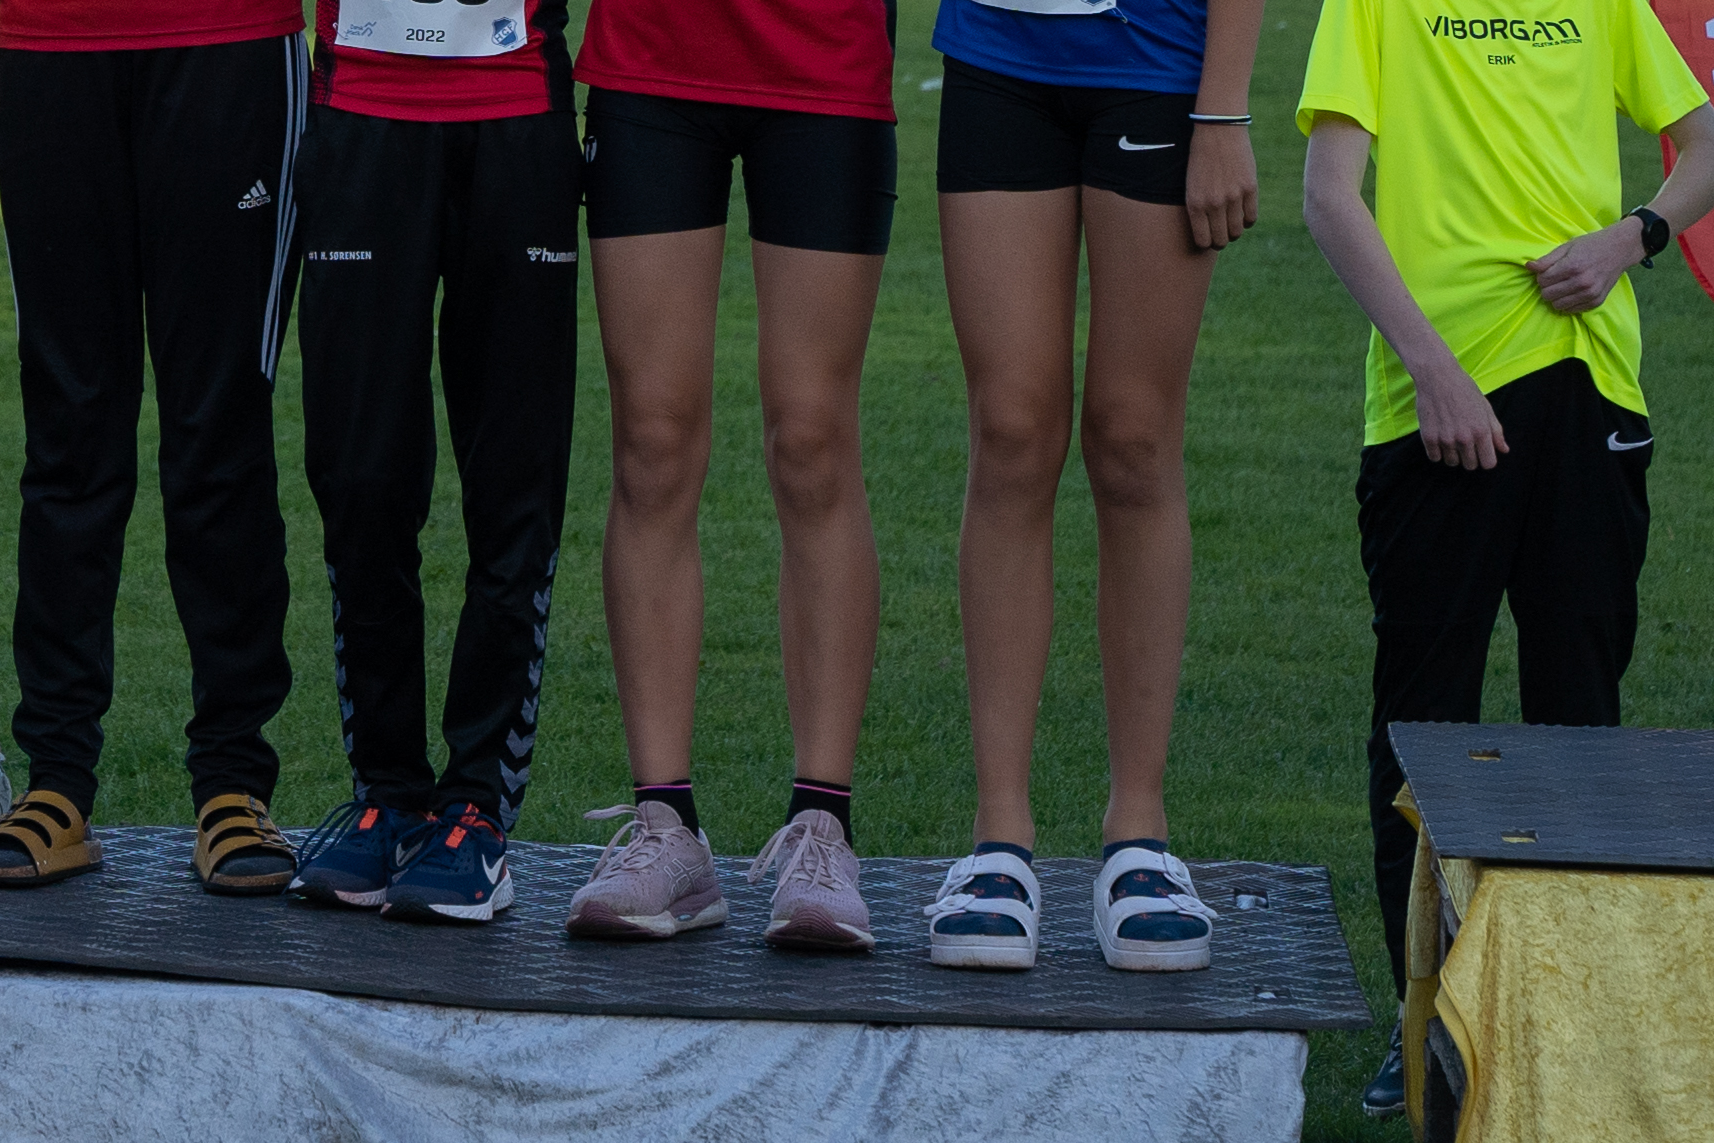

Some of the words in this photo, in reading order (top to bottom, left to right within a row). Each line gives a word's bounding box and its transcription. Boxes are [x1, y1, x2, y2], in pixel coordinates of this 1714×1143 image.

[405, 27, 446, 43] 2022
[1487, 54, 1517, 65] ERIK
[238, 195, 271, 209] adidas
